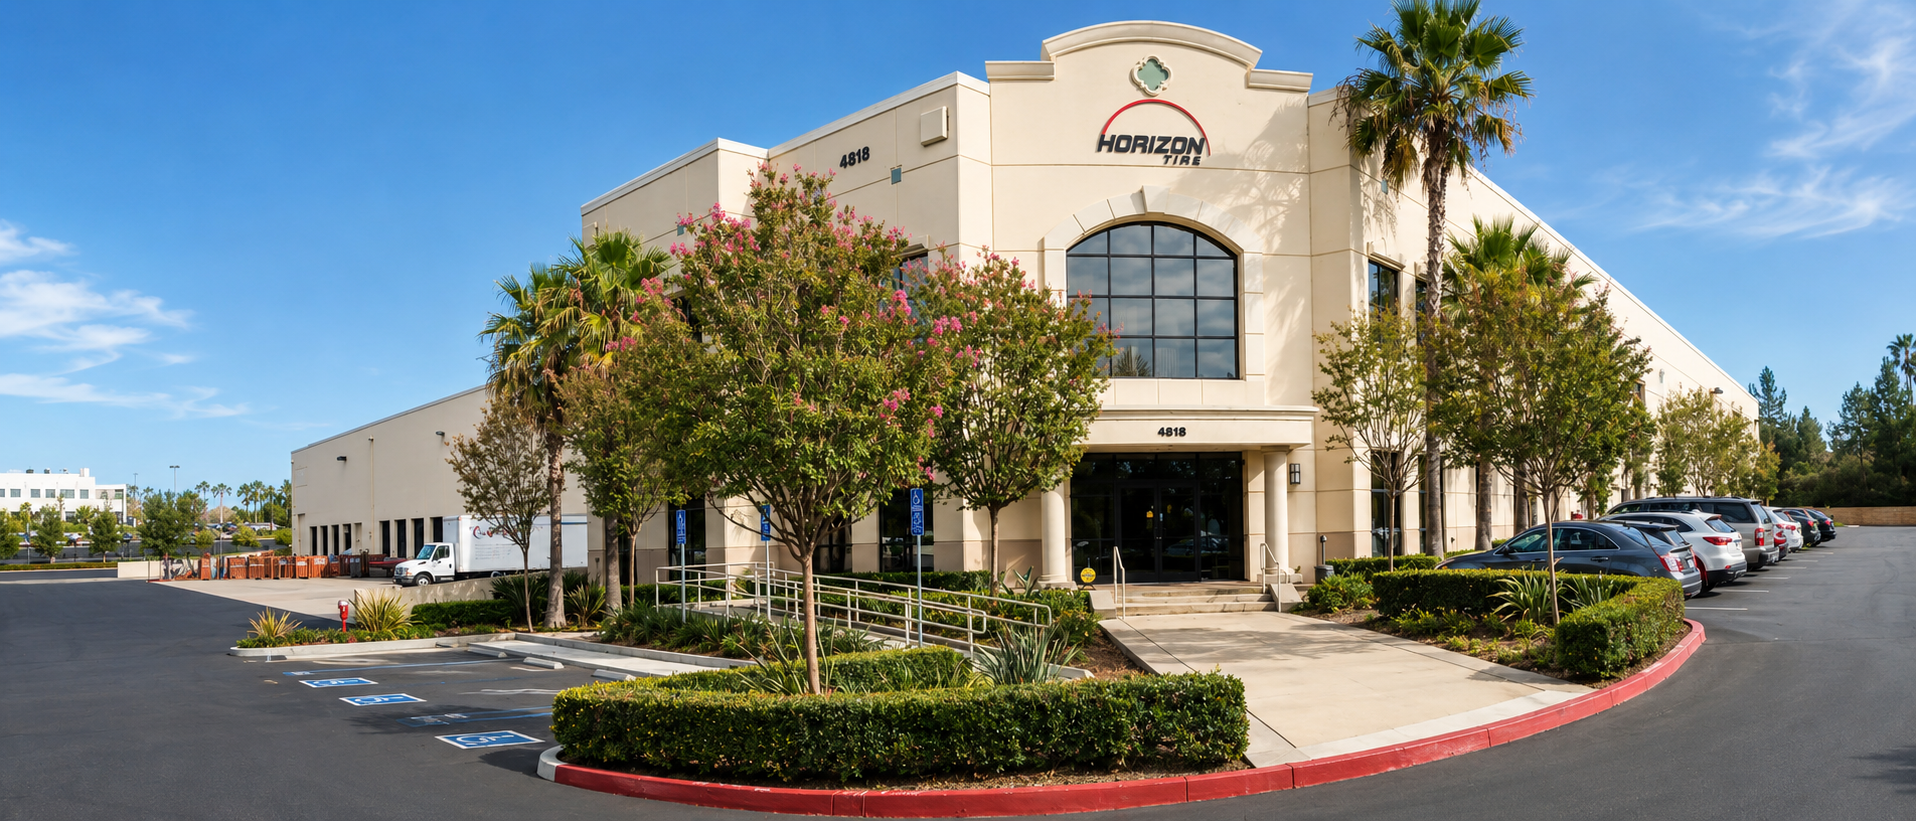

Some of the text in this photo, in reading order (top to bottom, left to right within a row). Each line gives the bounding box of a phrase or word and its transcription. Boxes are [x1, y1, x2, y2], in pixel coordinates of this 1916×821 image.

[1097, 134, 1205, 155] HORIZON
[839, 146, 870, 169] 4818
[1163, 155, 1201, 166] TIRE
[1157, 426, 1187, 437] 4818
